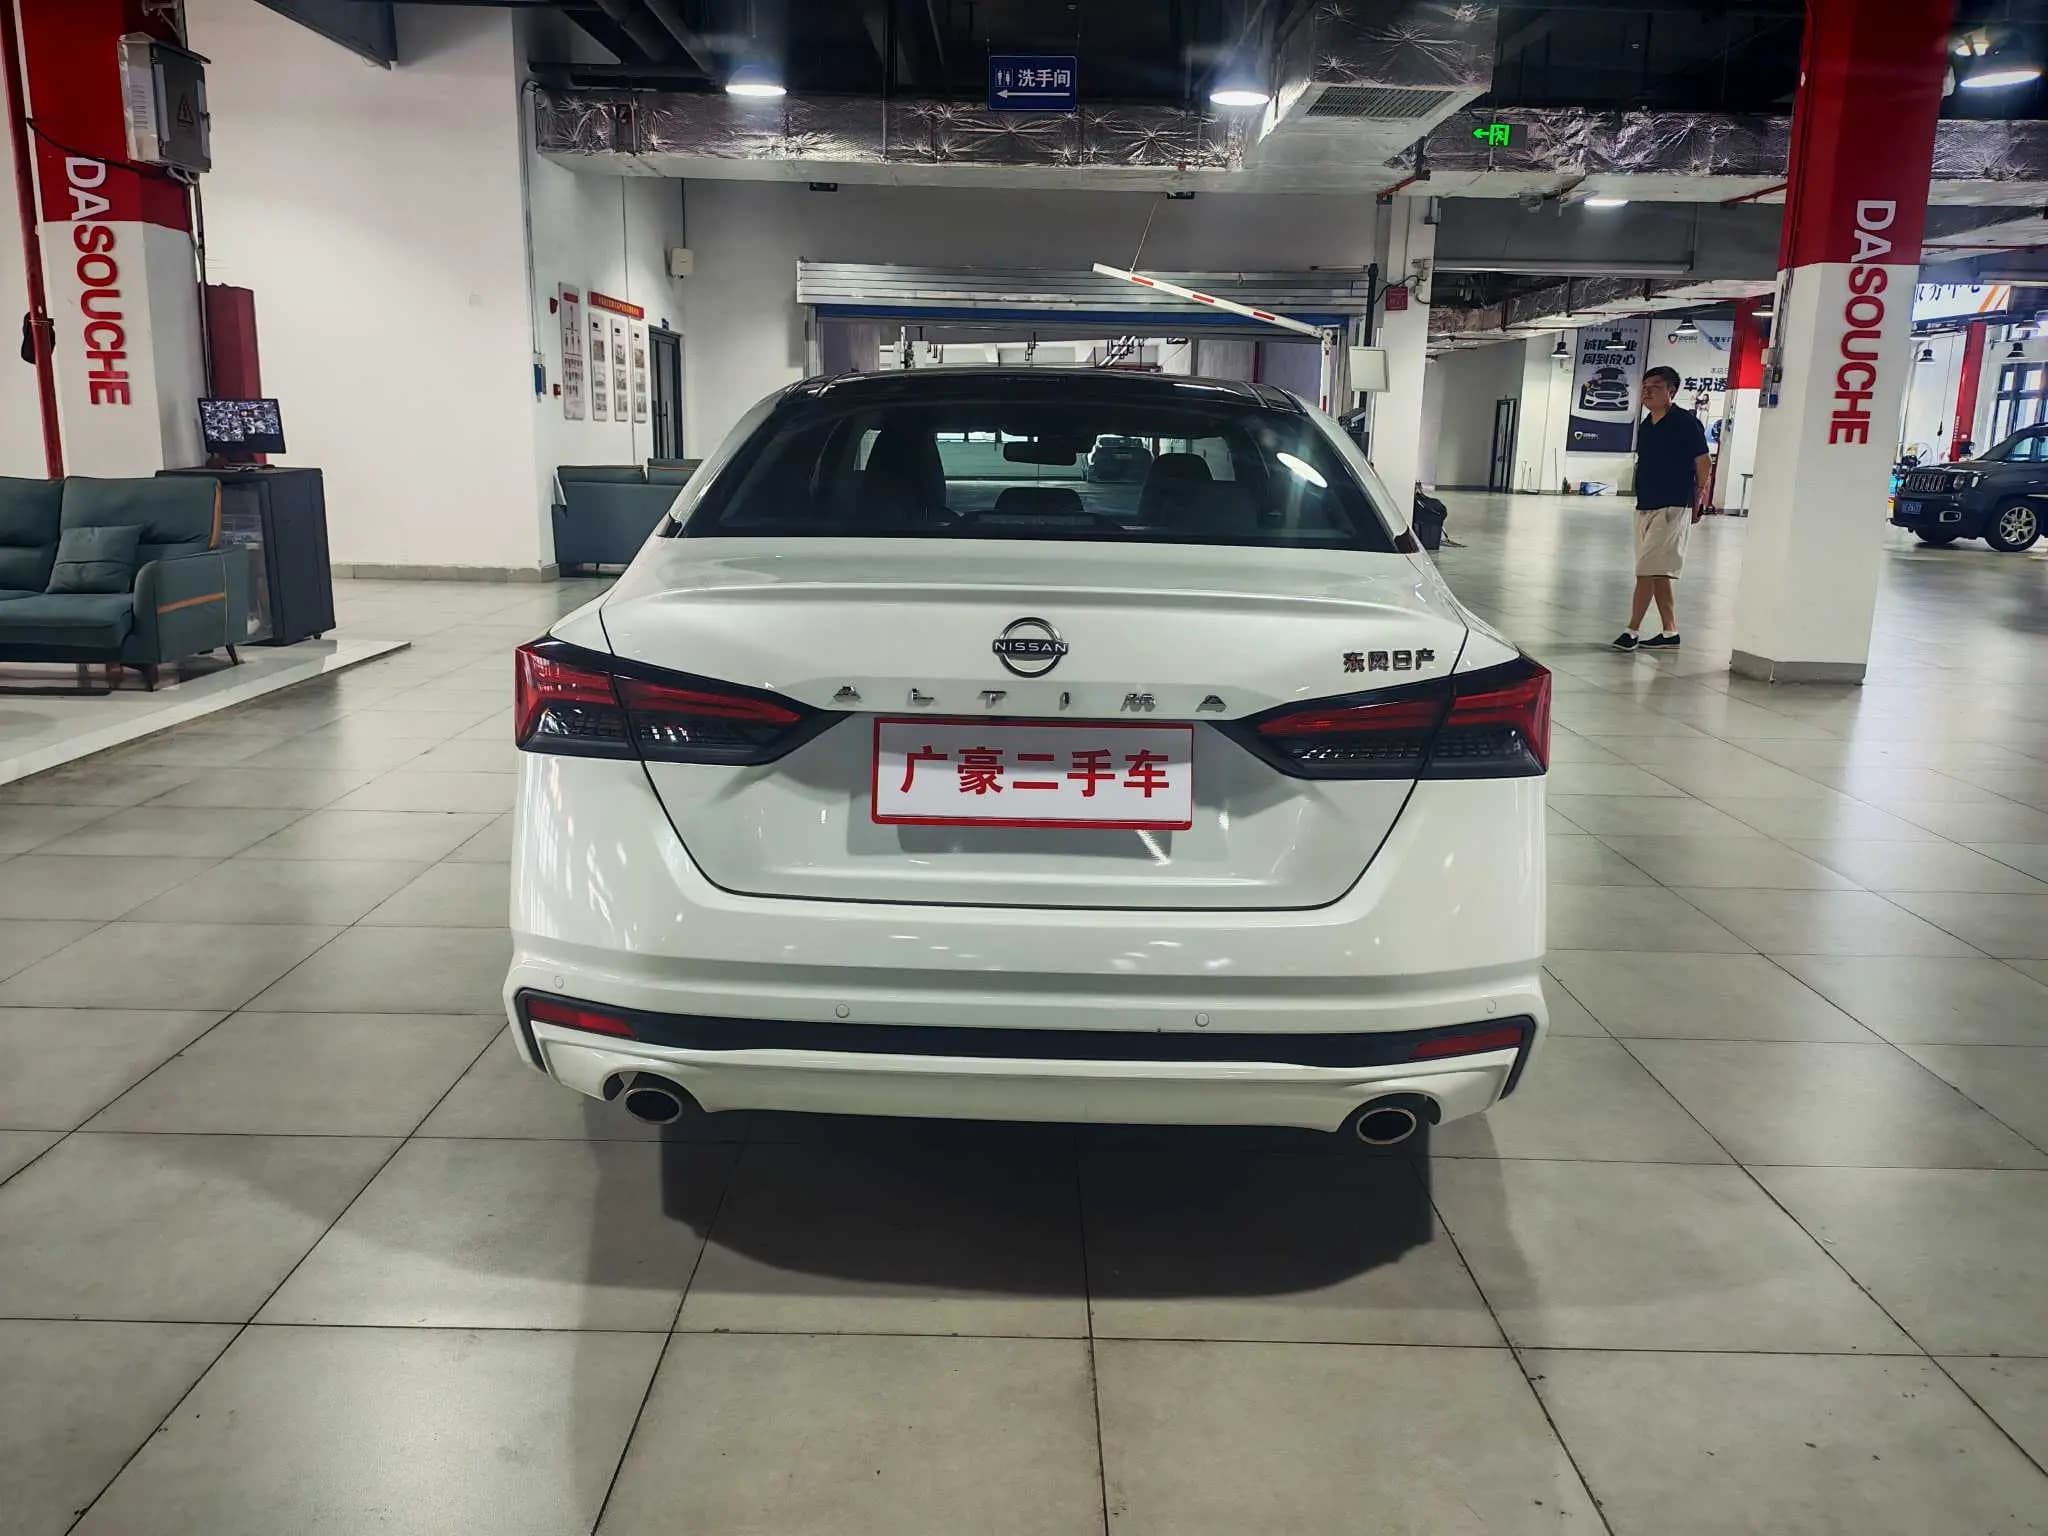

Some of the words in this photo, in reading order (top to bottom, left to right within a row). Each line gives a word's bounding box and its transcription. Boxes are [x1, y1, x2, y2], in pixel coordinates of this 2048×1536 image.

[1018, 69, 1071, 87] 洗手间
[64, 156, 131, 407] DASOUCHE
[1828, 199, 1897, 446] DASOUCHE
[1582, 353, 1636, 366] 周到放心
[993, 638, 1068, 655] NISSAN
[1343, 647, 1436, 674] 东风日产
[832, 685, 1228, 713] ALTIMA
[899, 744, 1170, 800] 广豪二手车
